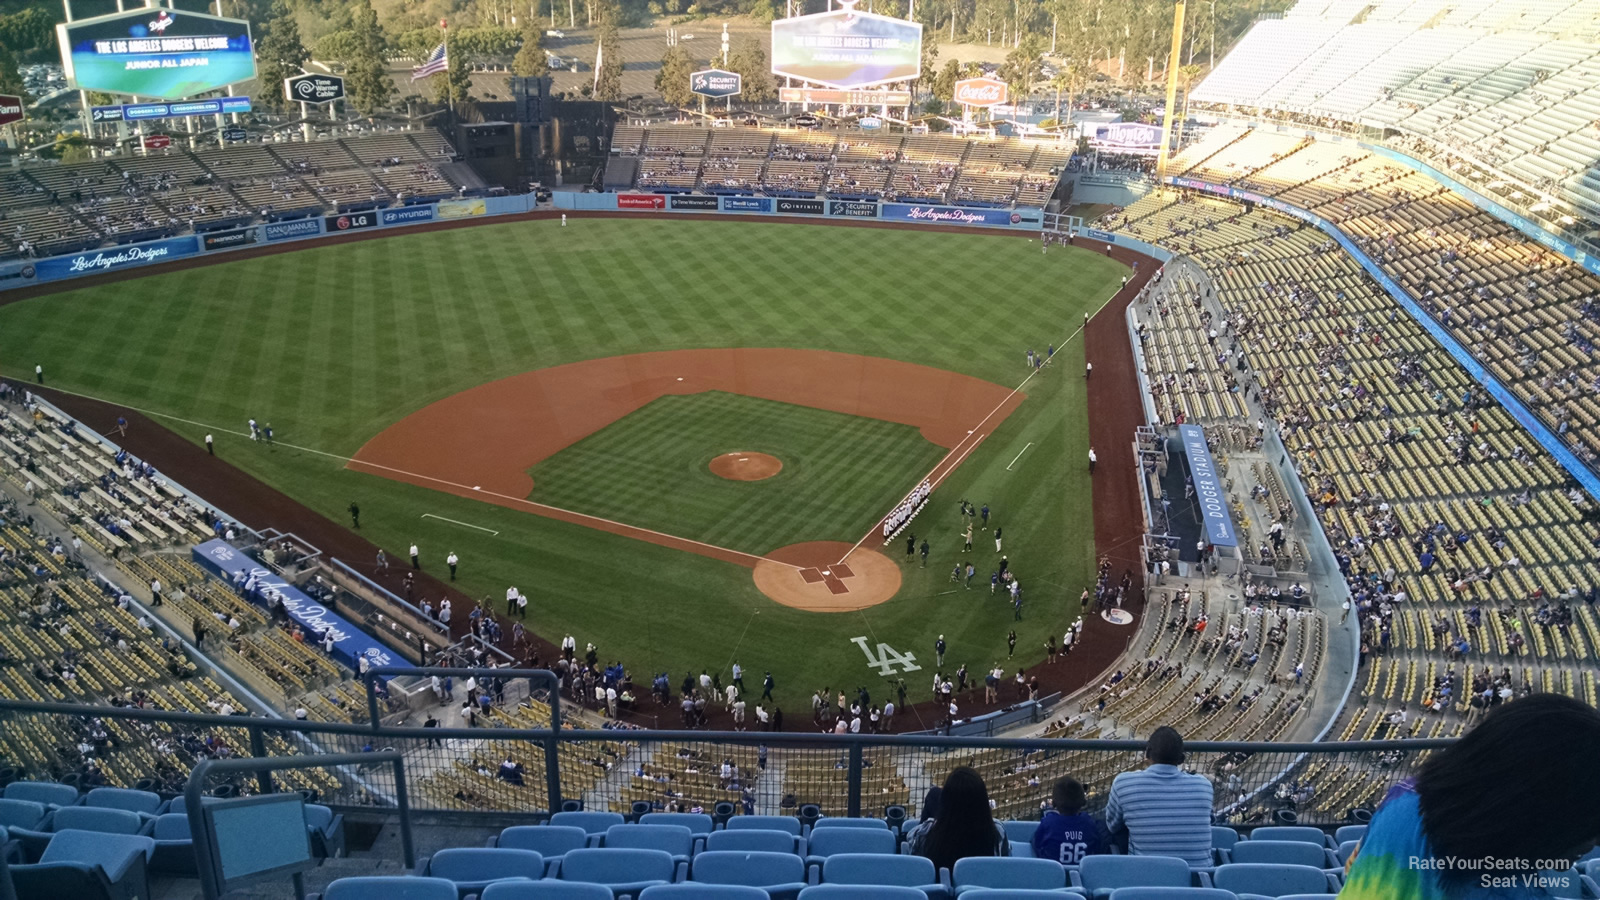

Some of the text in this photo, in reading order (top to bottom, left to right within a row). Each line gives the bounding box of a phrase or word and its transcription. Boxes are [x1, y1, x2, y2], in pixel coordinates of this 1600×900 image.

[96, 37, 228, 53] THE LOS ANGELES DODGERS WELCOME
[125, 58, 209, 70] JUNIOR ALL JAPAN
[352, 216, 367, 226] LG
[398, 209, 432, 219] HYUNDAI
[907, 207, 986, 223] Los Angeles Dodgers
[266, 225, 283, 235] SAN
[288, 221, 318, 232] MANUEL
[70, 247, 168, 271] Los Angeles Dodgers
[1190, 442, 1212, 477] STADIUM
[1200, 480, 1223, 518] DODGER
[850, 636, 922, 676] LA
[1064, 831, 1084, 840] PUIG
[1059, 842, 1088, 863] 66
